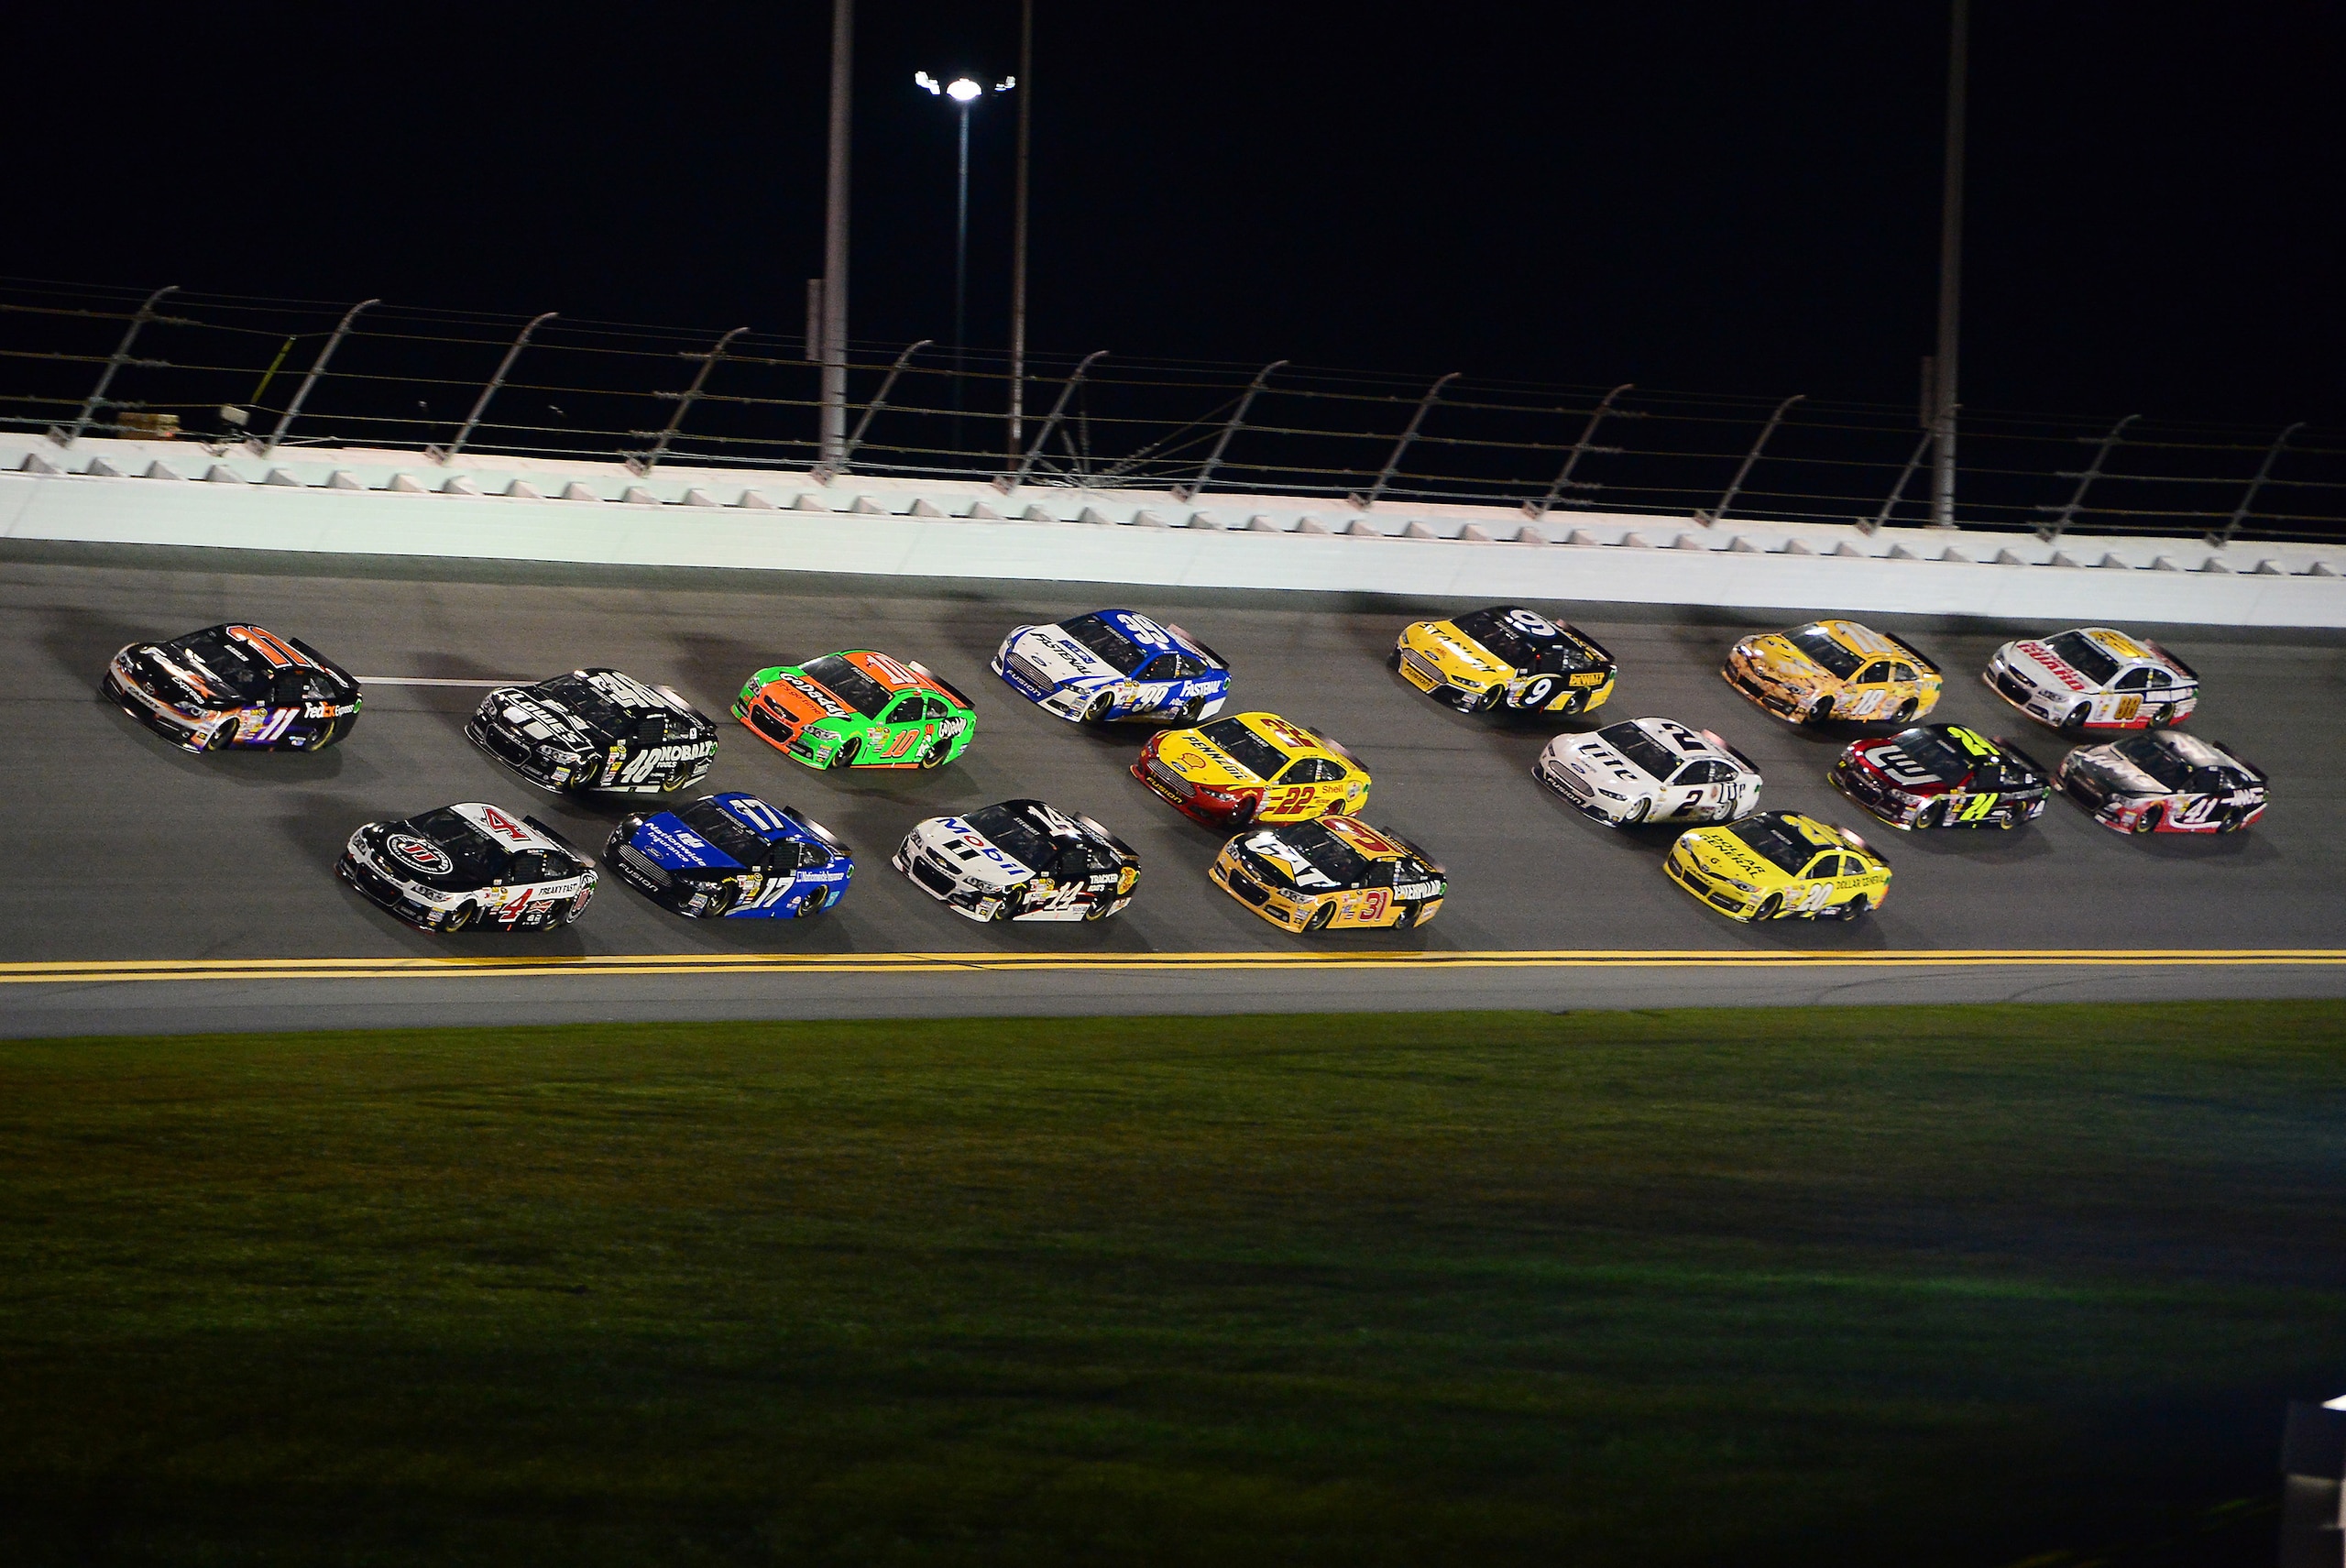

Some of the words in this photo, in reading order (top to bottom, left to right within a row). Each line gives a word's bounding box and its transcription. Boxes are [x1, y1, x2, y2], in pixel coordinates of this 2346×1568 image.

[1116, 613, 1170, 645] 99
[1509, 609, 1557, 637] 9
[225, 625, 312, 669] 11
[1029, 632, 1092, 675] FASTENAL
[865, 653, 920, 685] 10
[1006, 669, 1042, 696] FUSION
[127, 686, 160, 708] CAMRY
[171, 676, 205, 705] Express
[587, 671, 666, 708] 48
[1131, 685, 1169, 713] 99
[1524, 677, 1552, 705] 9
[1849, 689, 1887, 716] 18
[303, 700, 336, 718] FedEx
[2113, 695, 2143, 720] 88
[257, 707, 301, 740] 11
[1260, 718, 1319, 748] 22
[1661, 722, 1708, 751] 2
[659, 740, 715, 762] KOBALT
[880, 728, 921, 758] 10
[1946, 726, 2001, 756] 24
[620, 748, 662, 784] 48
[1146, 776, 1184, 805] FUSION
[1272, 786, 1316, 815] 22
[1321, 784, 1344, 795] Shell
[1547, 777, 1583, 805] FUSION
[1669, 789, 1705, 817] 2
[729, 799, 785, 831] 17
[1959, 793, 1999, 820] 24
[2182, 797, 2219, 824] 41
[481, 806, 532, 842] 4
[1013, 817, 1041, 836] STEWART
[1027, 806, 1084, 841] 14
[645, 822, 707, 867] Nationwide
[647, 831, 689, 862] Insurance
[935, 817, 1026, 876] Mobil
[1698, 834, 1760, 879] GENERAL
[1710, 834, 1766, 873] DOLLAR
[618, 862, 660, 893] FUSION
[751, 876, 796, 909] 17
[1089, 873, 1119, 884] TRACKER
[1836, 878, 1861, 890] DOLLAR
[498, 887, 534, 924] 4
[1043, 880, 1085, 912] 14
[1358, 889, 1389, 921] 31
